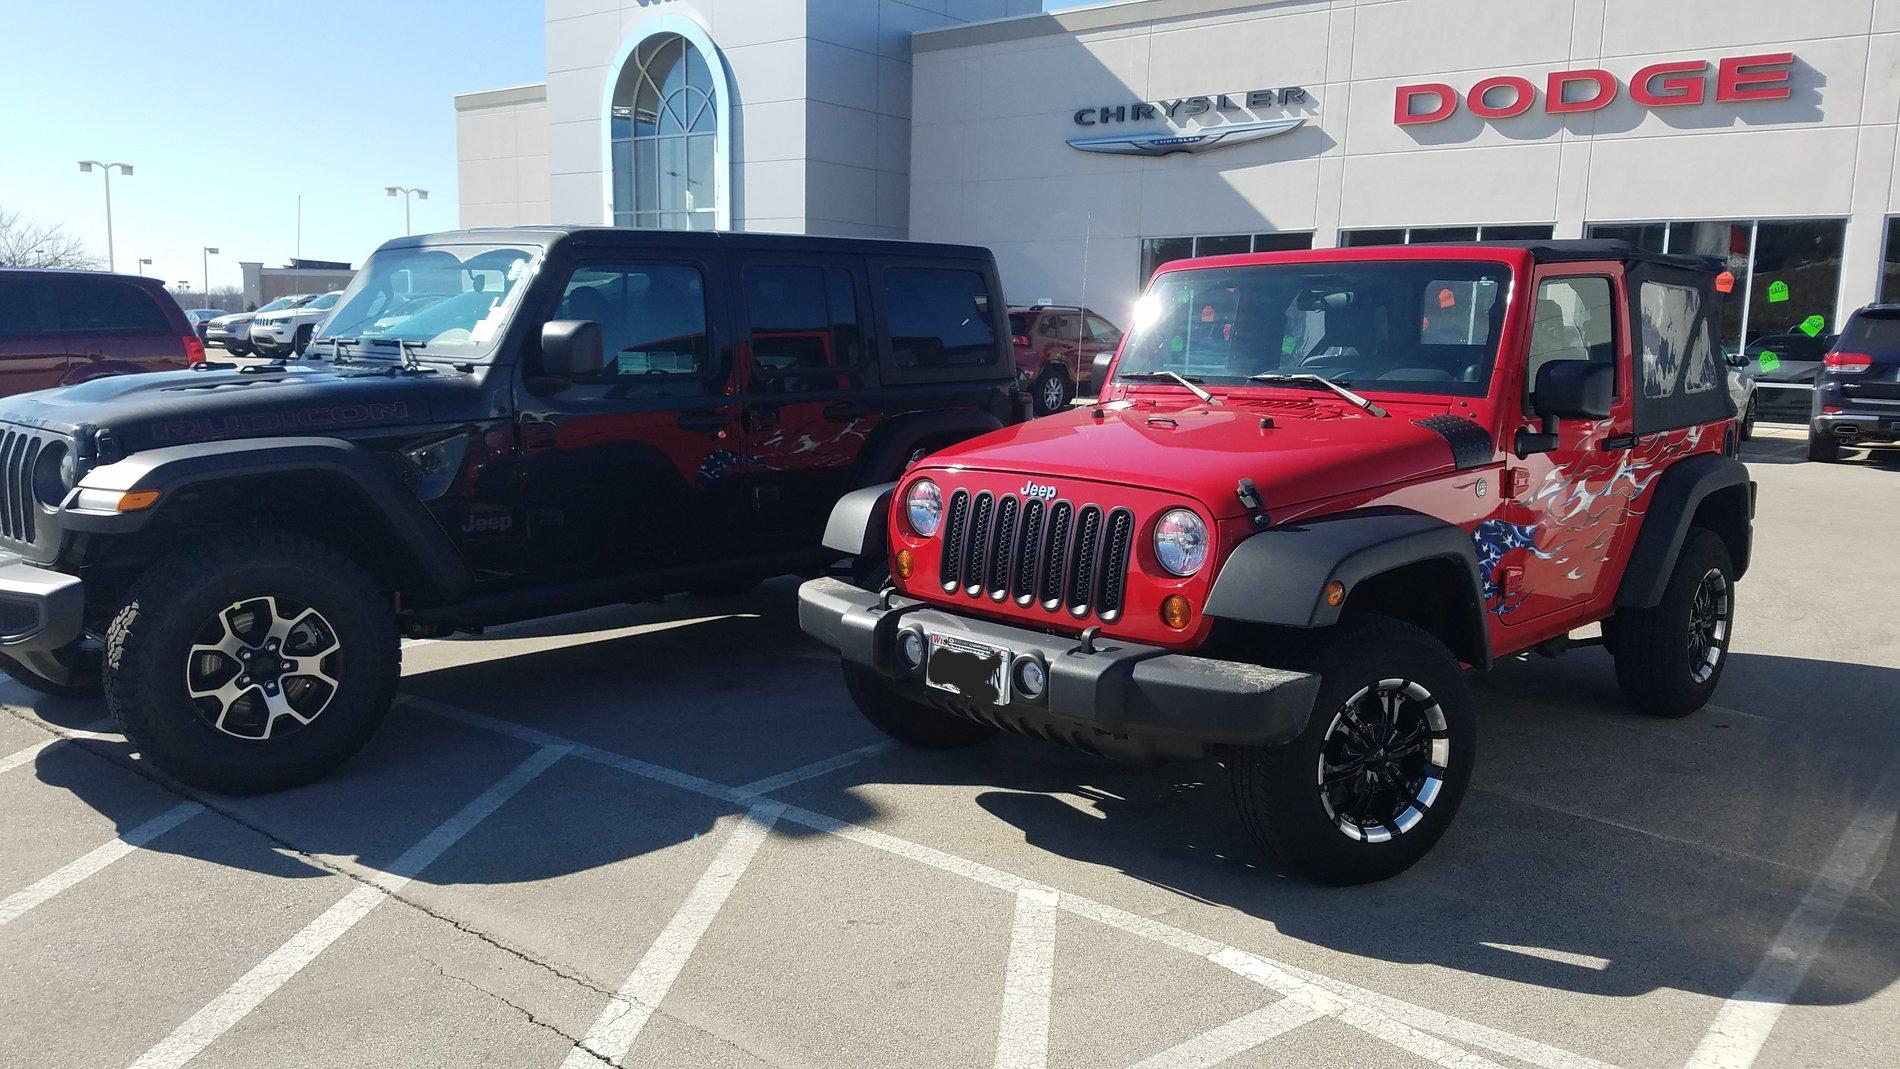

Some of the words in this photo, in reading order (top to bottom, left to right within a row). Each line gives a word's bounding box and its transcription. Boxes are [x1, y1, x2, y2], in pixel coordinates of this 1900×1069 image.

[1394, 52, 1794, 125] DODGE
[1073, 86, 1306, 126] CHRYSLER
[1153, 136, 1200, 145] CHRYSLER
[152, 401, 409, 440] RUBICON
[1020, 480, 1057, 500] Jeep
[460, 514, 513, 532] Jeep
